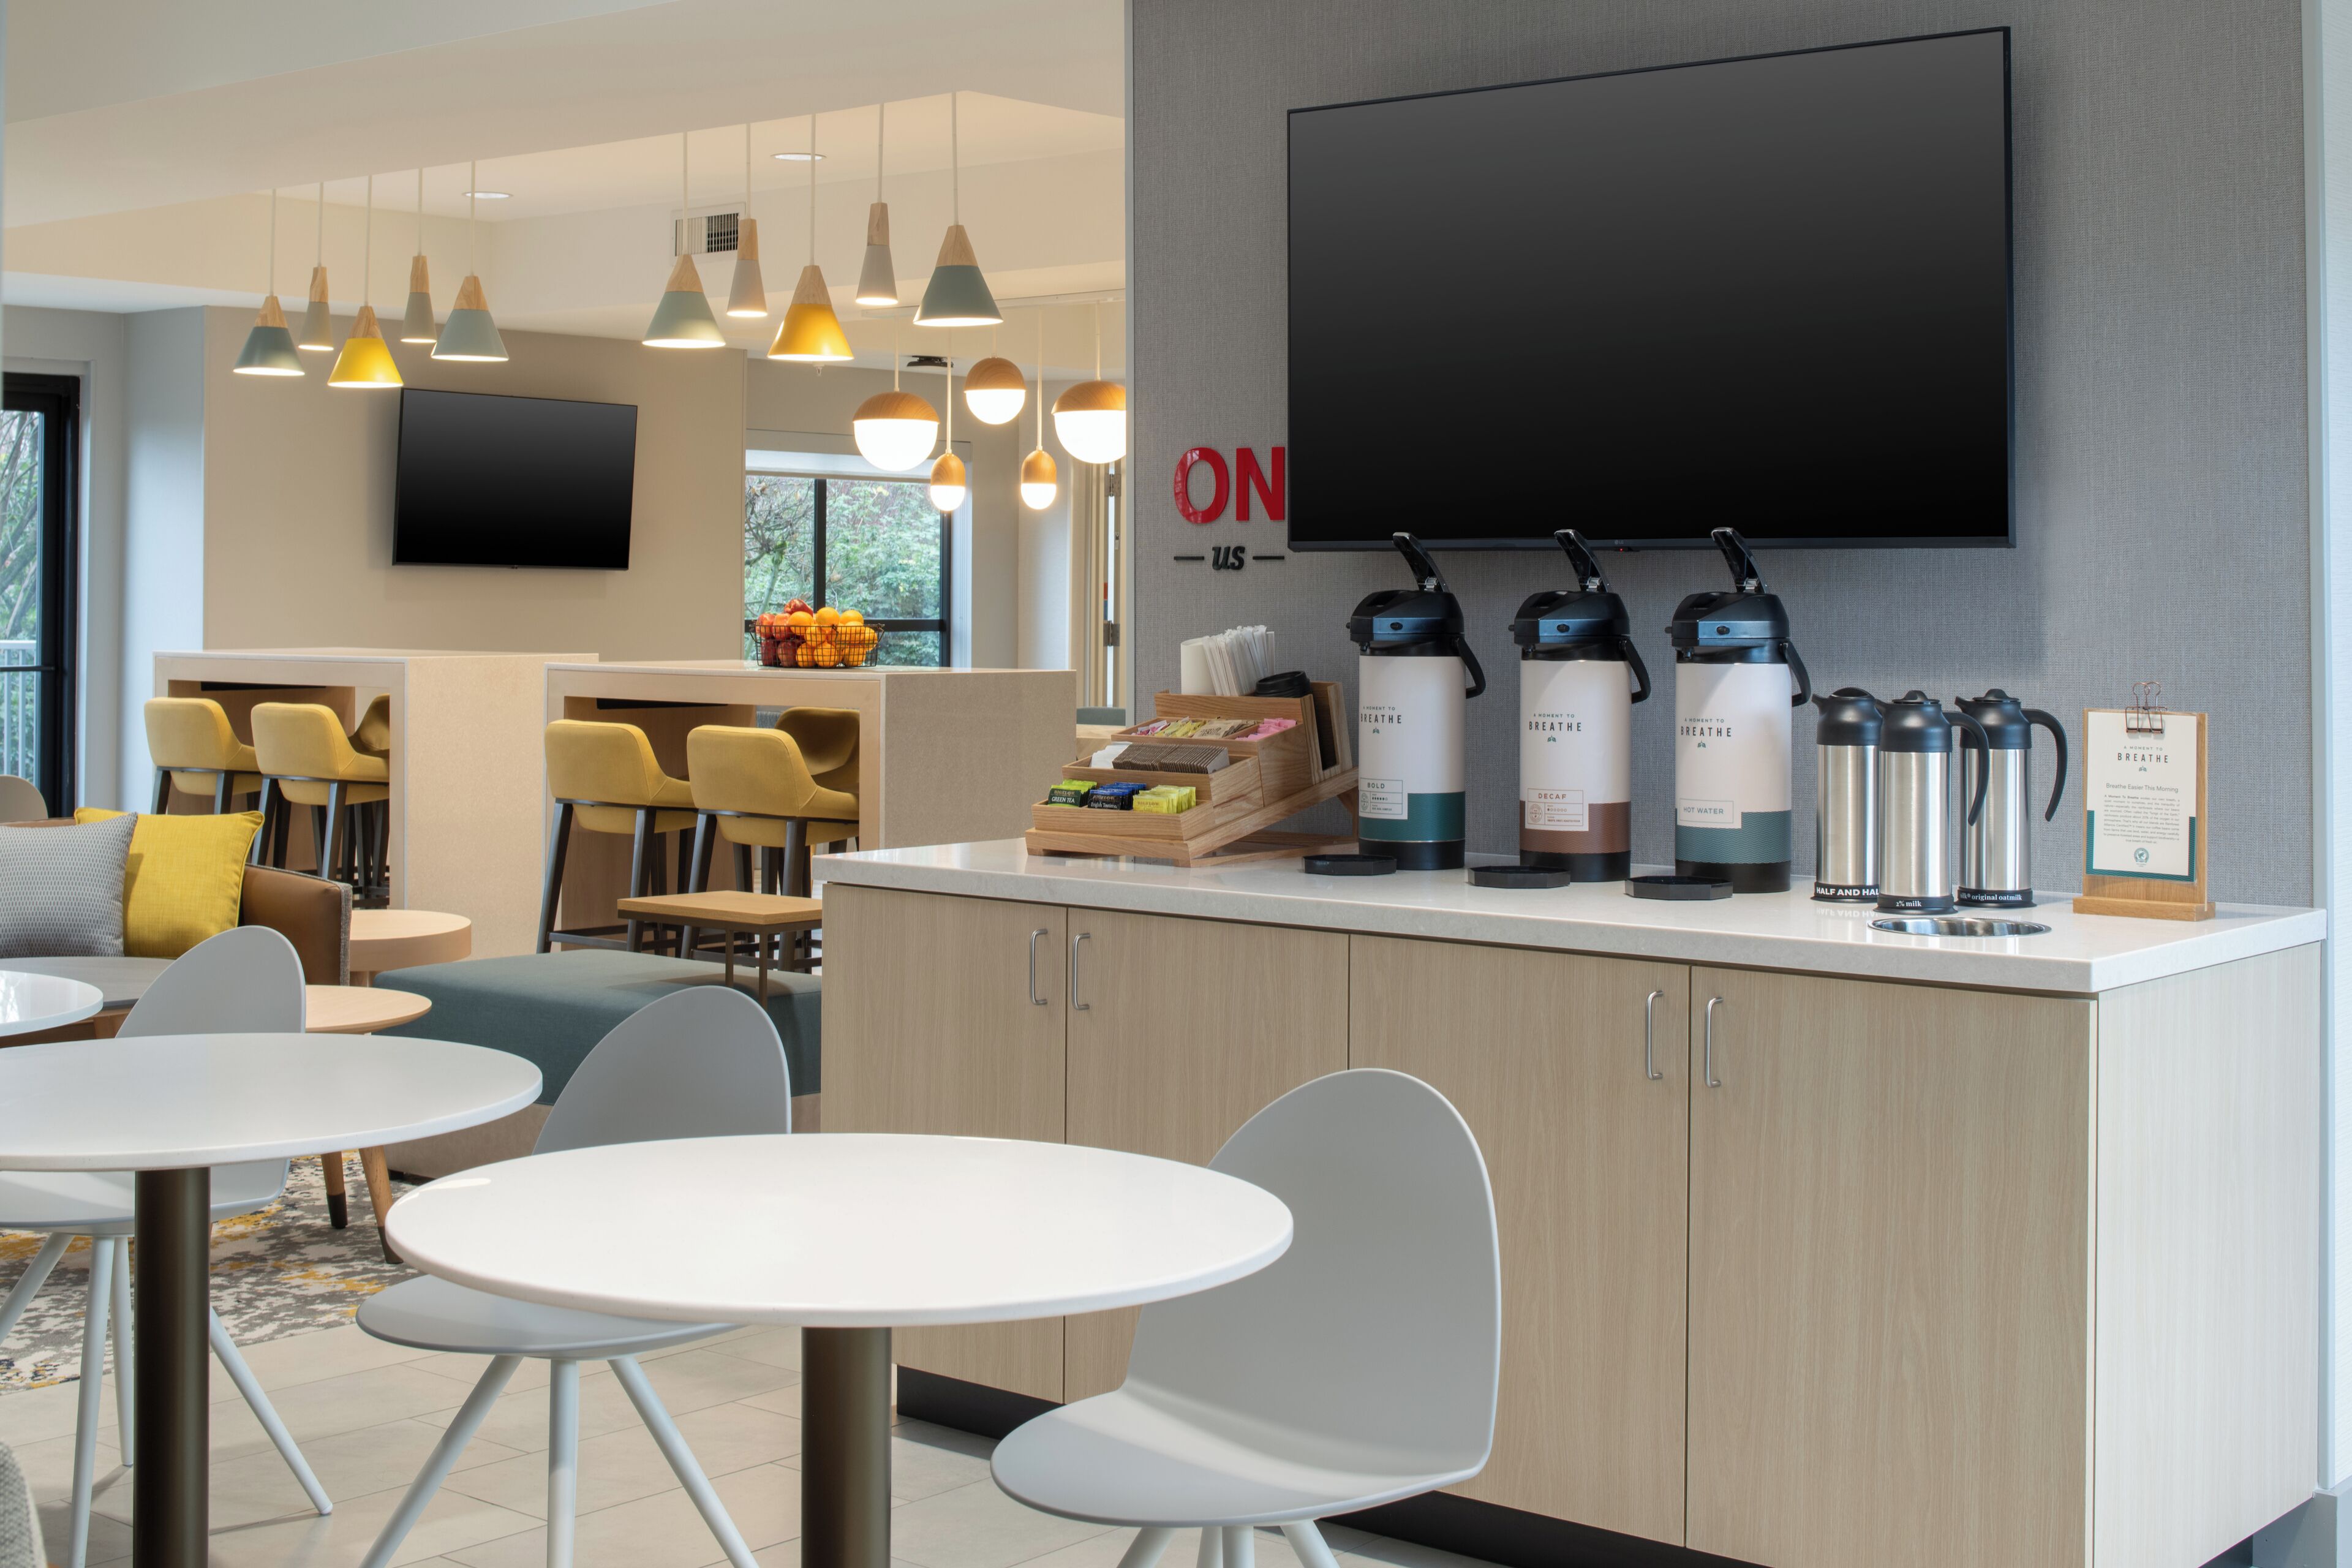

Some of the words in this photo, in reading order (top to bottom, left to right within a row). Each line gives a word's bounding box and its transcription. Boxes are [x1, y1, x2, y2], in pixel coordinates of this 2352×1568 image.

[1174, 447, 1285, 524] ON
[1212, 546, 1245, 570] us
[1361, 714, 1401, 723] BREATHE
[1529, 721, 1581, 731] BREATHE
[1681, 726, 1732, 737] BREATHE
[2117, 753, 2168, 763] BREATHE
[1816, 887, 1836, 895] HALF
